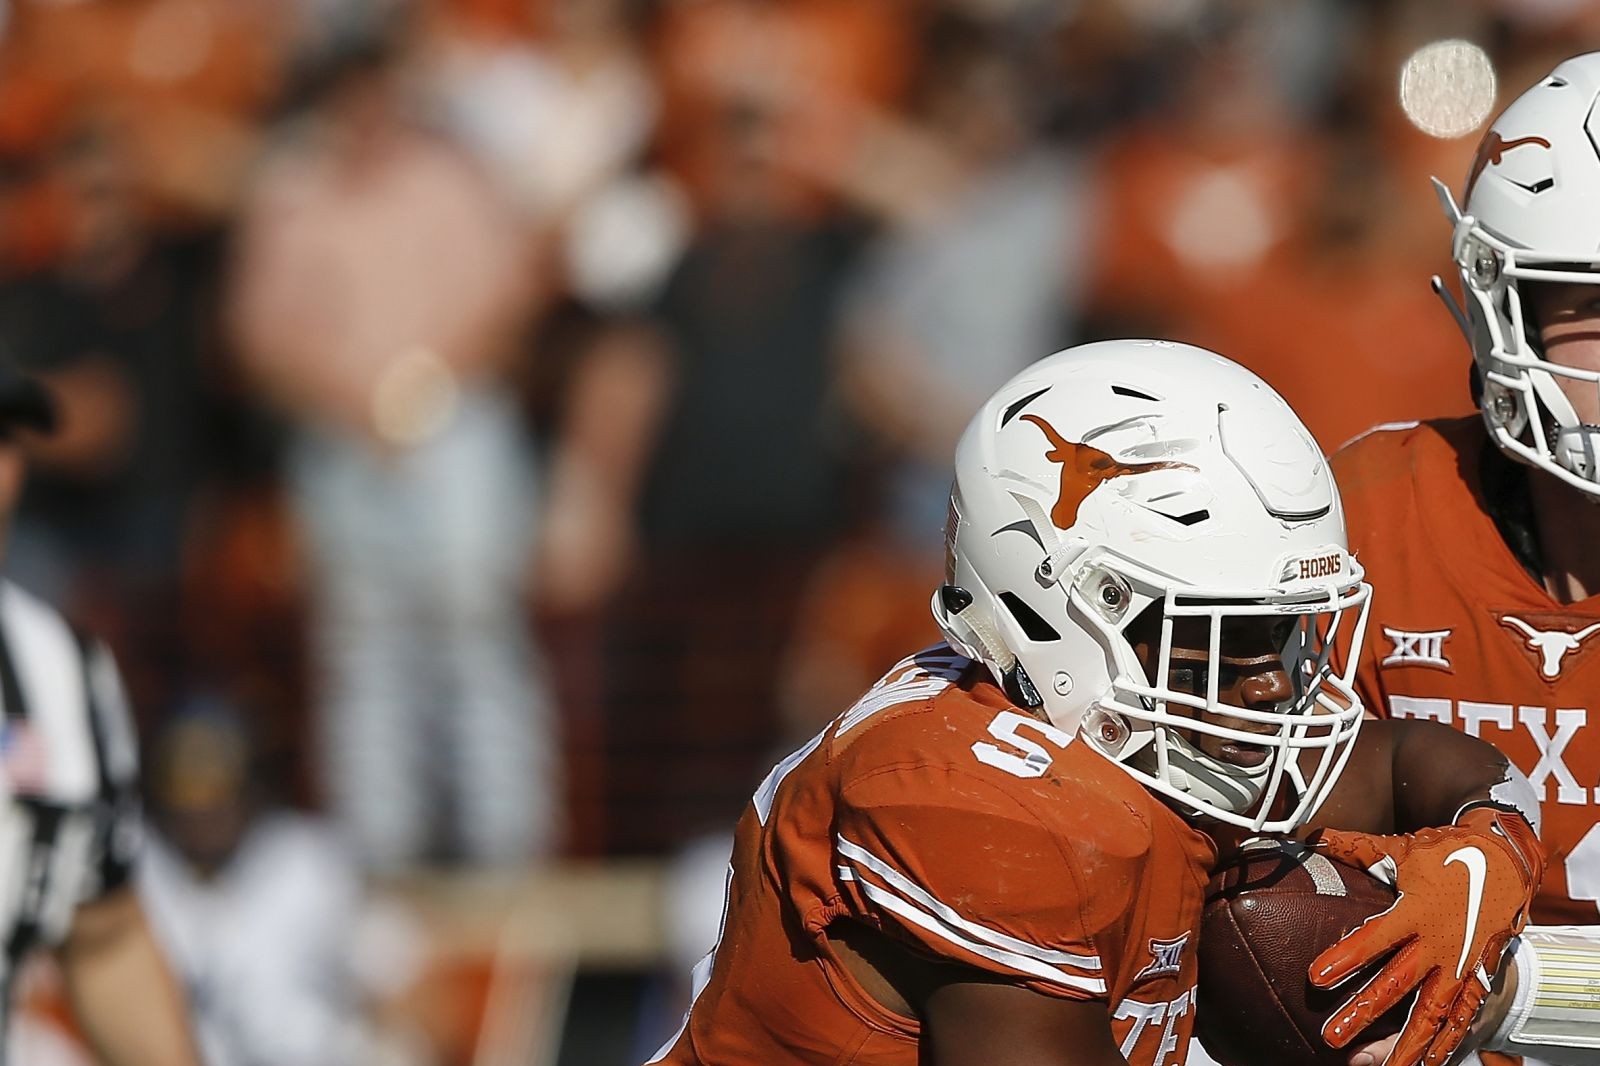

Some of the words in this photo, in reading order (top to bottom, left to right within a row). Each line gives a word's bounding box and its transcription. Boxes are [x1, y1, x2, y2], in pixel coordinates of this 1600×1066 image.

[1299, 554, 1341, 579] HORNS
[1382, 628, 1452, 668] XII
[970, 710, 1076, 779] 5
